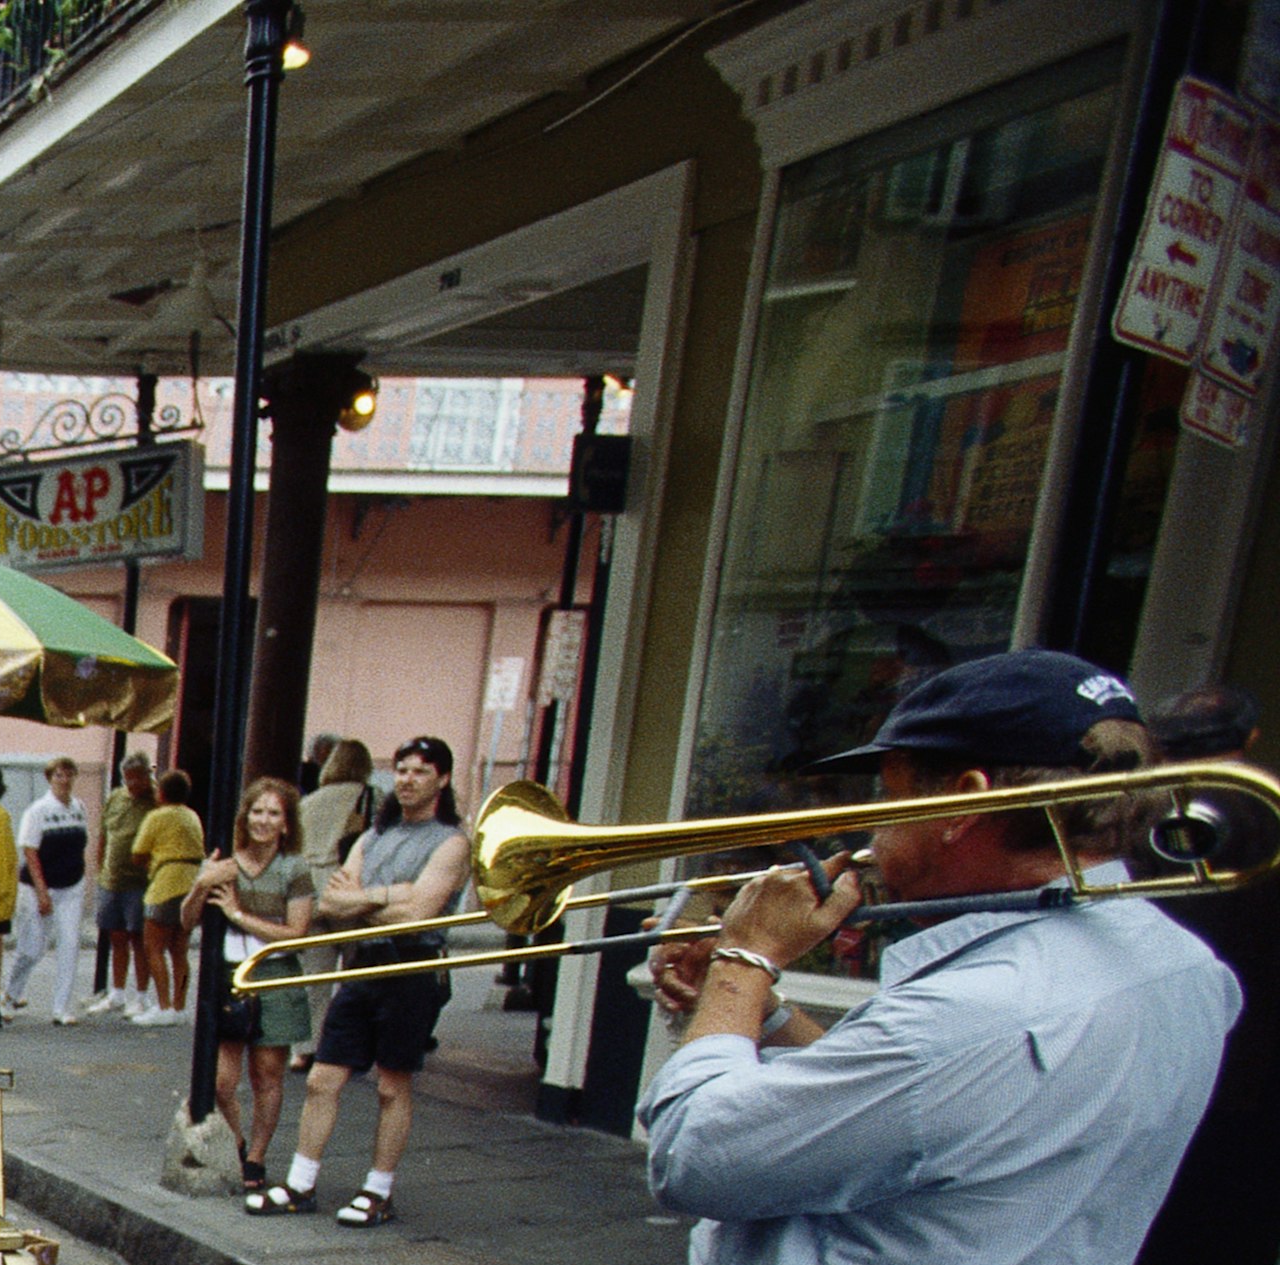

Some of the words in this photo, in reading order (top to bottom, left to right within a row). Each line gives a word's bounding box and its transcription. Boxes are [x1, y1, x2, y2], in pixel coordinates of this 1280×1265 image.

[1189, 168, 1213, 204] TO
[1158, 194, 1224, 242] CORNER
[1136, 266, 1205, 319] ANYTIME
